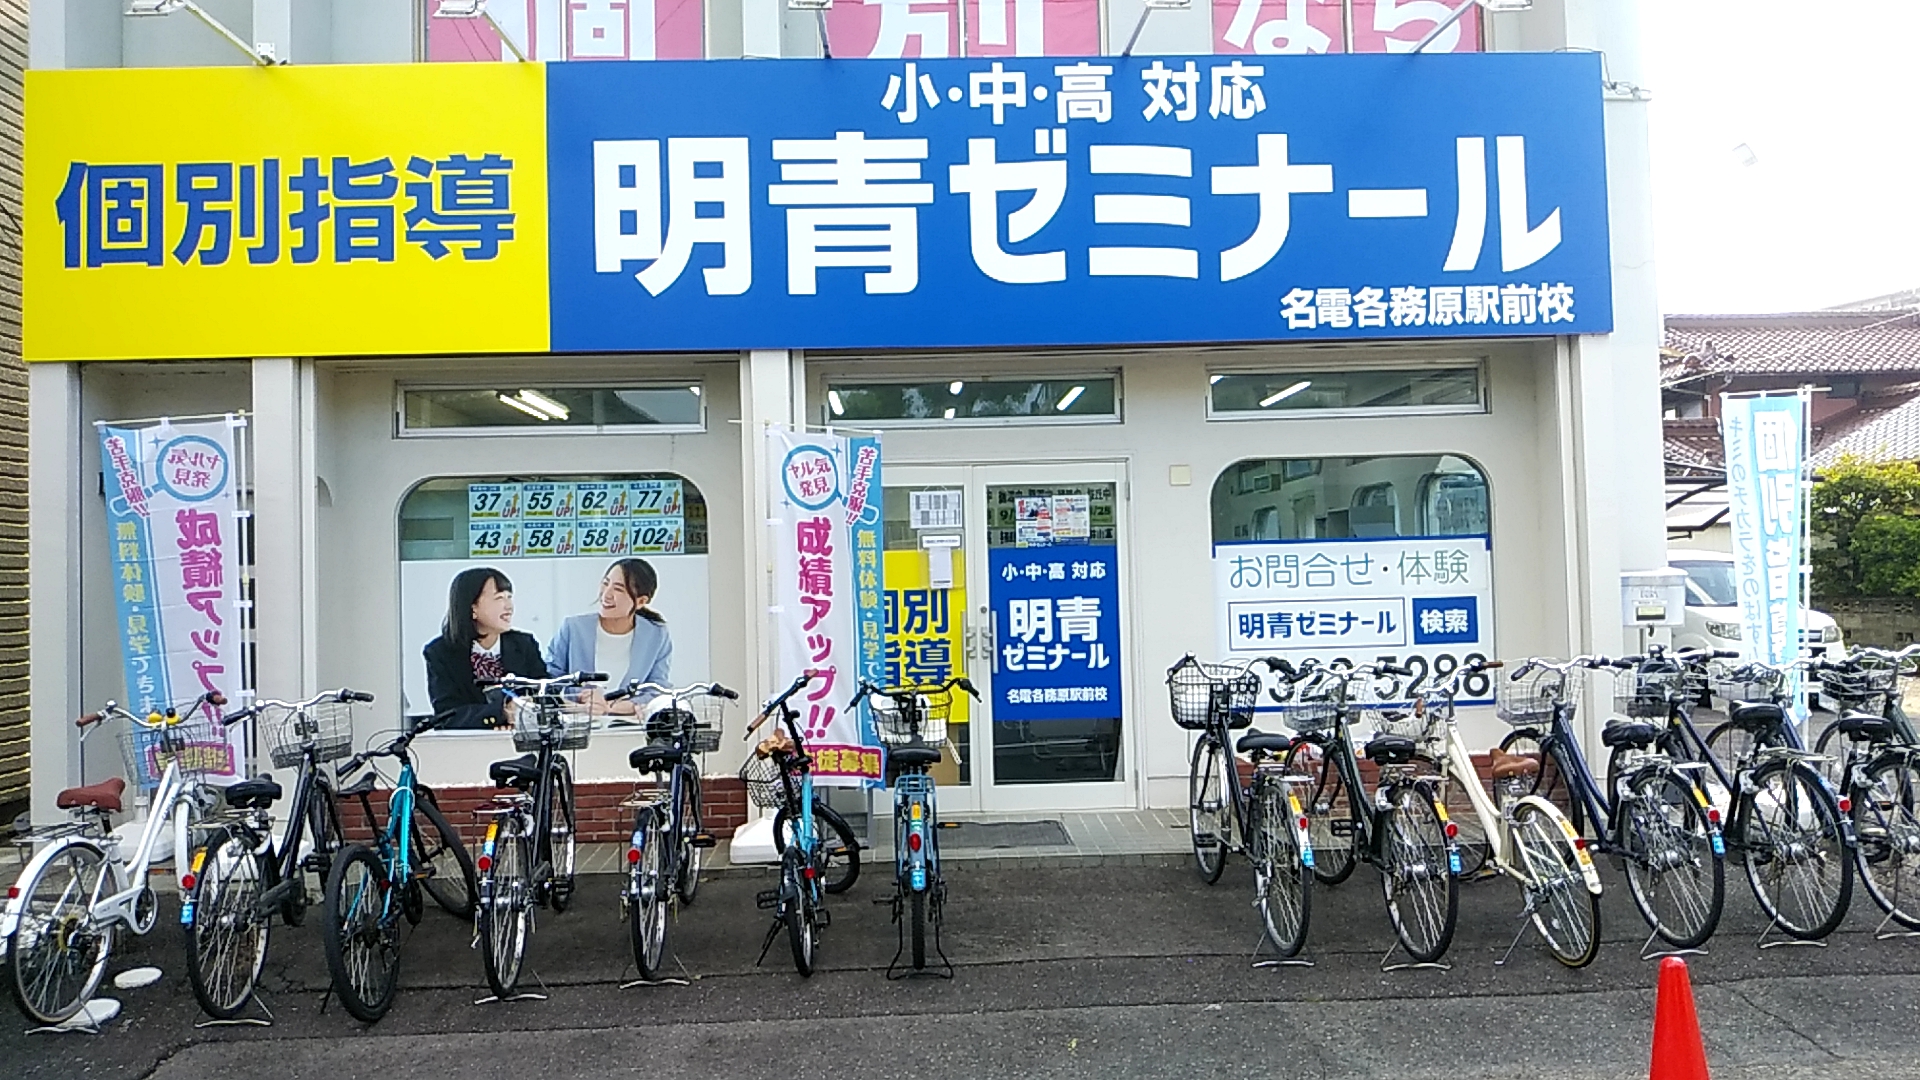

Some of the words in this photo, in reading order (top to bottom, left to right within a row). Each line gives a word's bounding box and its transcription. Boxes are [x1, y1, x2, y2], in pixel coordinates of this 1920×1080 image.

[881, 61, 1113, 124] 小・中・高
[1142, 61, 1266, 121] 対応
[55, 154, 516, 269] 個別指導
[593, 129, 1561, 297] 明青ゼミナール
[1280, 283, 1575, 330] 名電各務原駅前校
[788, 457, 832, 479] ヤル気
[799, 477, 832, 498] 発見
[846, 447, 877, 525] 苦手克服!!
[474, 492, 502, 511] 37
[527, 491, 555, 510] 55
[581, 491, 608, 509] 62
[637, 490, 663, 508] 77
[475, 531, 502, 549] 43
[527, 529, 555, 547] 58
[583, 528, 609, 546] 58
[632, 527, 668, 545] 102
[1002, 562, 1066, 581] 小・中・高
[1072, 561, 1106, 580] 対応
[1229, 549, 1469, 588] お問合せ・体験
[797, 516, 836, 739] 成績アップ!!
[1009, 596, 1102, 643] 明青
[1238, 610, 1397, 639] 明青ゼミナール
[1419, 609, 1469, 634] 検索
[1002, 642, 1110, 671] ゼミナール
[1006, 686, 1108, 704] 名電各務原駅前校
